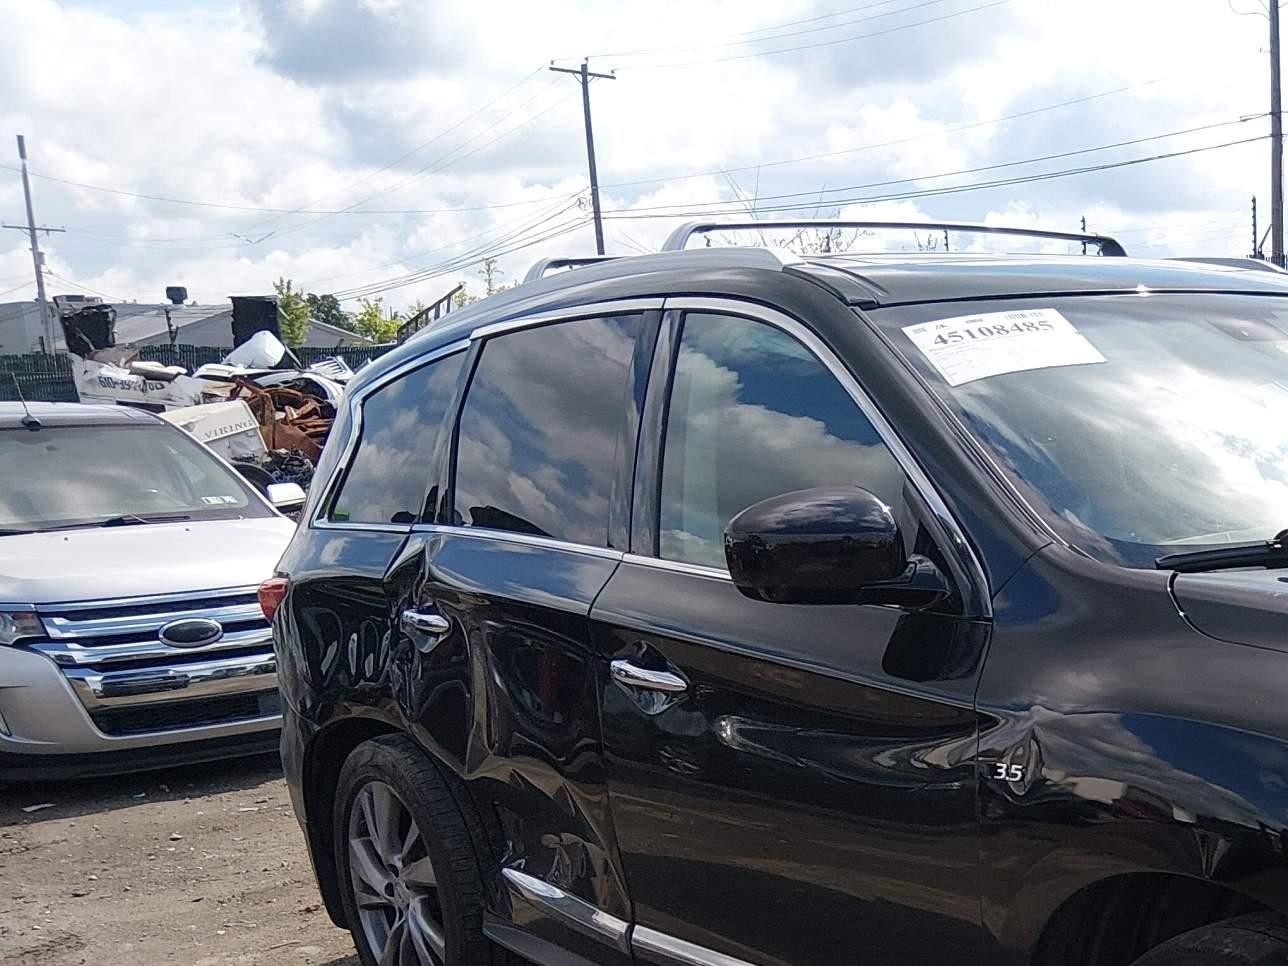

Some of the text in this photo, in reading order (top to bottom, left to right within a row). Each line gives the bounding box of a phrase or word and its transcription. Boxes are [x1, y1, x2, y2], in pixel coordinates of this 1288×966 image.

[933, 320, 1054, 346] 45108485
[204, 420, 254, 439] VIKING
[994, 762, 1024, 782] 3.5
